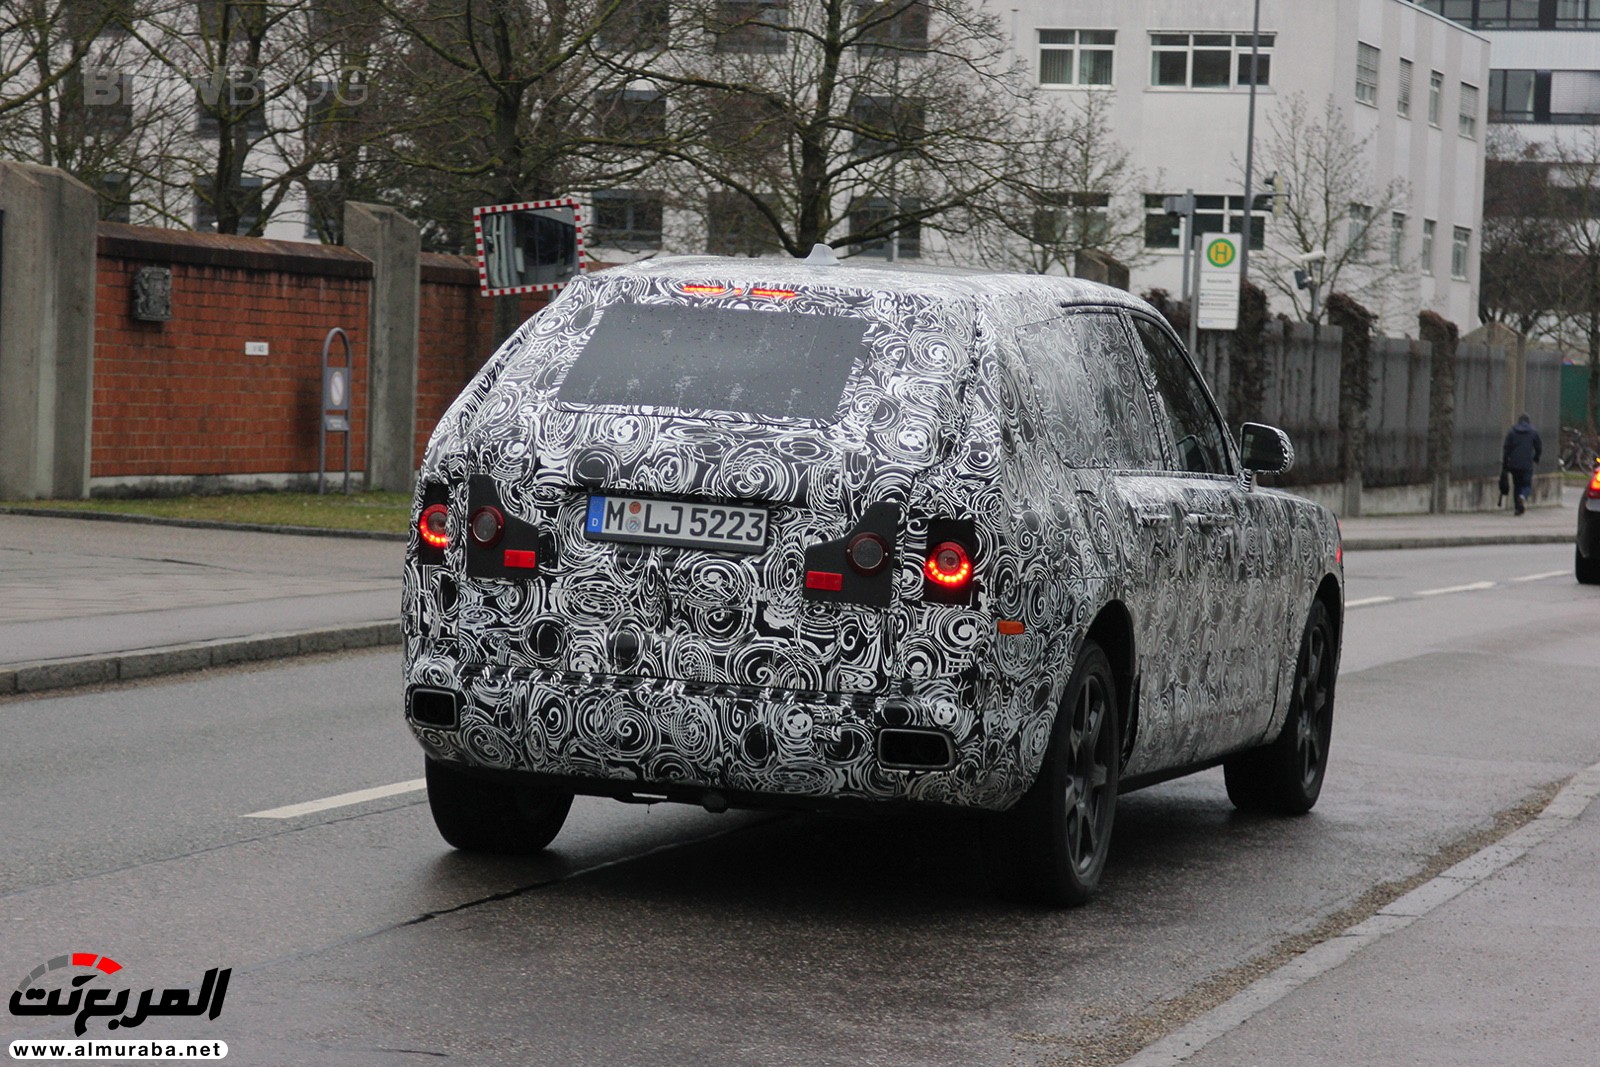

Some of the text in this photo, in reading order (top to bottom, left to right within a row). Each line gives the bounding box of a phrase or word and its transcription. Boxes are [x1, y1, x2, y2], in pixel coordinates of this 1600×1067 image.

[1215, 245, 1228, 262] H
[591, 501, 765, 542] D M LJ 5223
